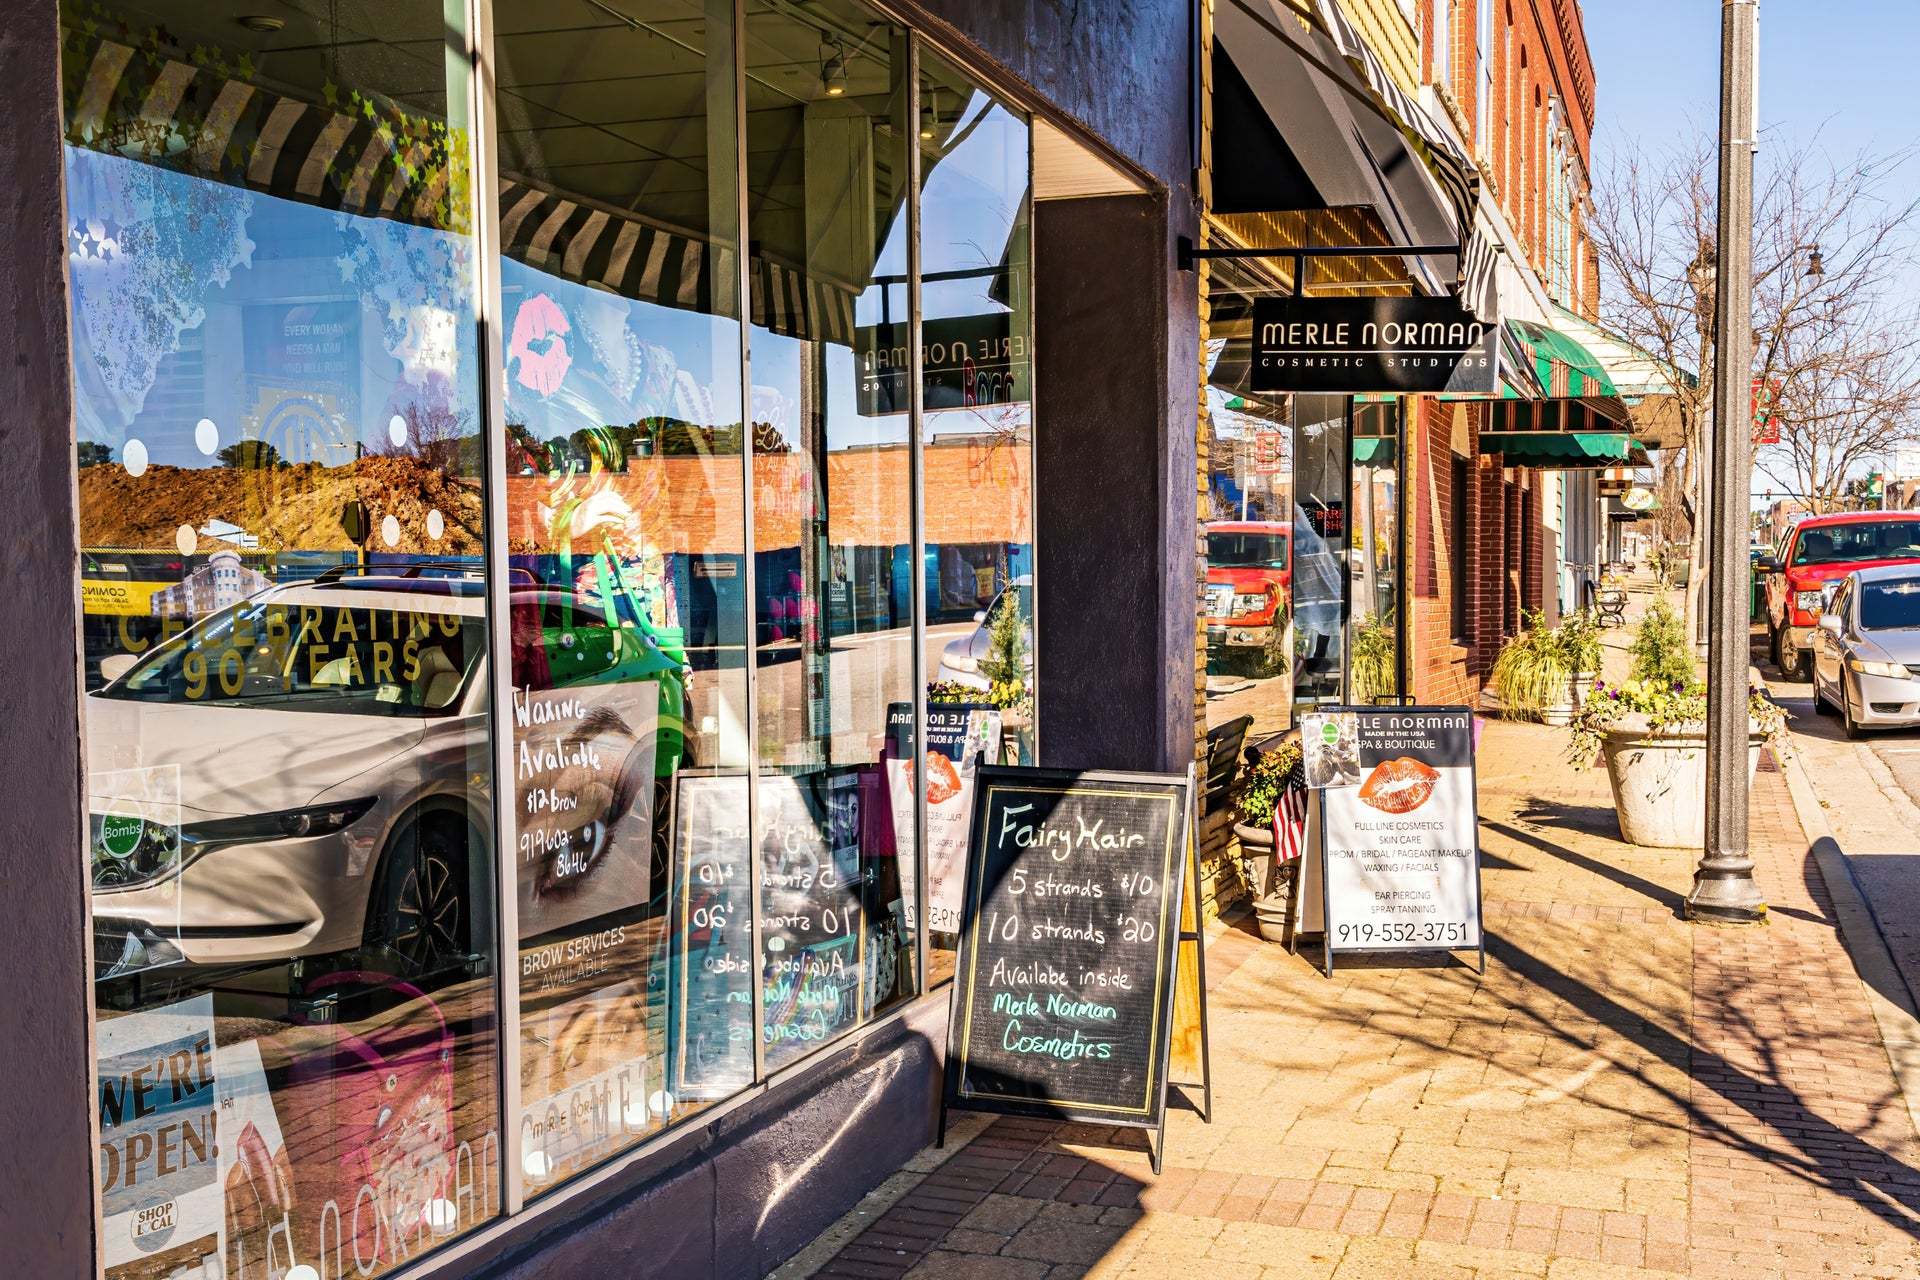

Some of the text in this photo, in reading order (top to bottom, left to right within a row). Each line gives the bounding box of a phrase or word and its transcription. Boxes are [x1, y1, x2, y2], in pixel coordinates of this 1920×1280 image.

[1262, 322, 1484, 345] MERLE NORMAN
[1262, 358, 1488, 367] COSMETIC STUDIOS
[118, 602, 461, 652] CELEBRATING
[182, 639, 421, 699] 90 YEARS
[1376, 740, 1383, 749] &
[1385, 740, 1436, 749] BOUTIQUE
[105, 824, 141, 839] Bombs
[1355, 822, 1444, 830] FULL LINE COSMETICS
[1379, 836, 1421, 844] SKIN CARE
[556, 852, 587, 877] 8646
[1361, 850, 1390, 858] BRIDAL
[1398, 850, 1437, 858] PAGEANT
[1364, 863, 1399, 872] WAXING
[1406, 863, 1438, 871] FACIALS
[1008, 869, 1153, 898] 5 strands $10
[1375, 891, 1431, 900] EAR PIERCING
[1371, 905, 1436, 914] SPRAY TANNING
[988, 912, 1155, 944] 10 strands $20
[1338, 923, 1467, 942] 919-552-3751
[523, 926, 625, 976] BROW SERVICES
[541, 953, 608, 993] AVAILABLE
[989, 957, 1132, 990] Availabe inside
[993, 993, 1117, 1020] Merle Norman
[1002, 1018, 1112, 1059] Cosmetics
[100, 1036, 215, 1133] WE'RE
[101, 1109, 219, 1194] OPEN!
[138, 1202, 173, 1223] SHOP
